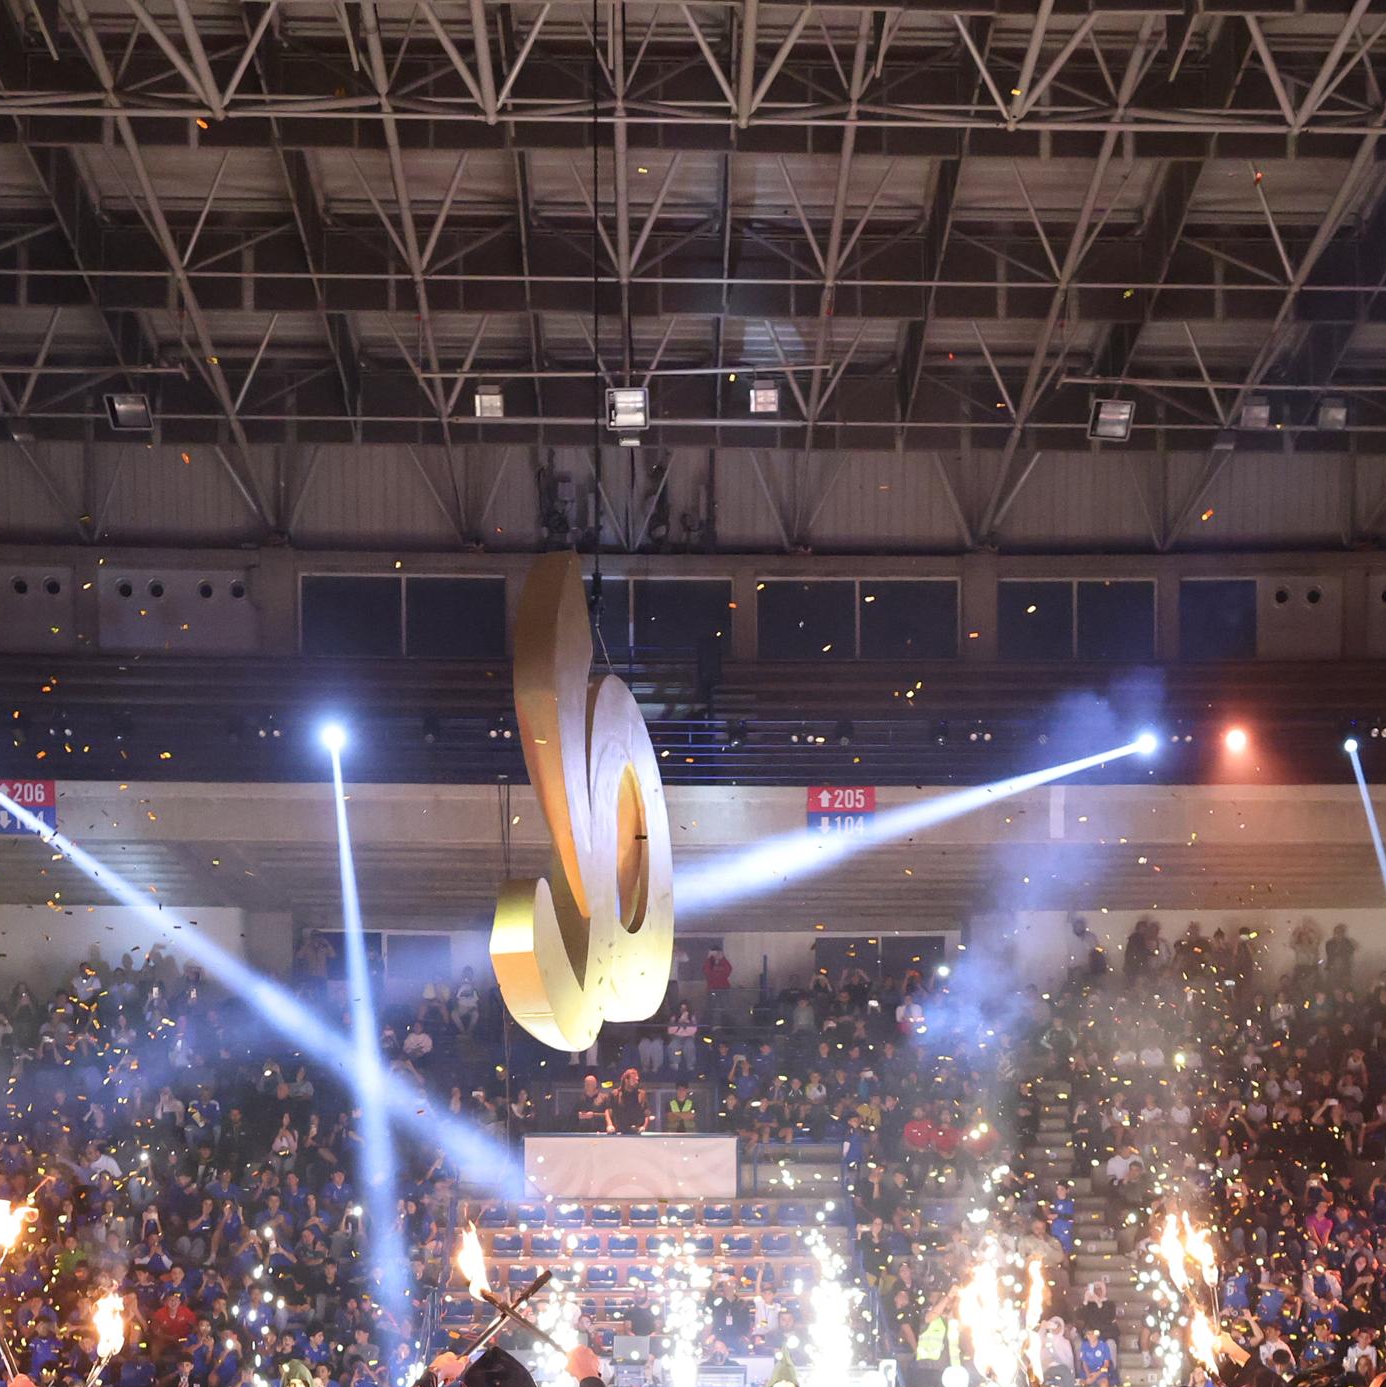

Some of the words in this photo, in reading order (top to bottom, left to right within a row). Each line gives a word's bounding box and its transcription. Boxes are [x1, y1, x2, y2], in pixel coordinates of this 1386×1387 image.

[13, 783, 45, 802] 206
[834, 789, 865, 808] 205
[834, 816, 864, 835] 104
